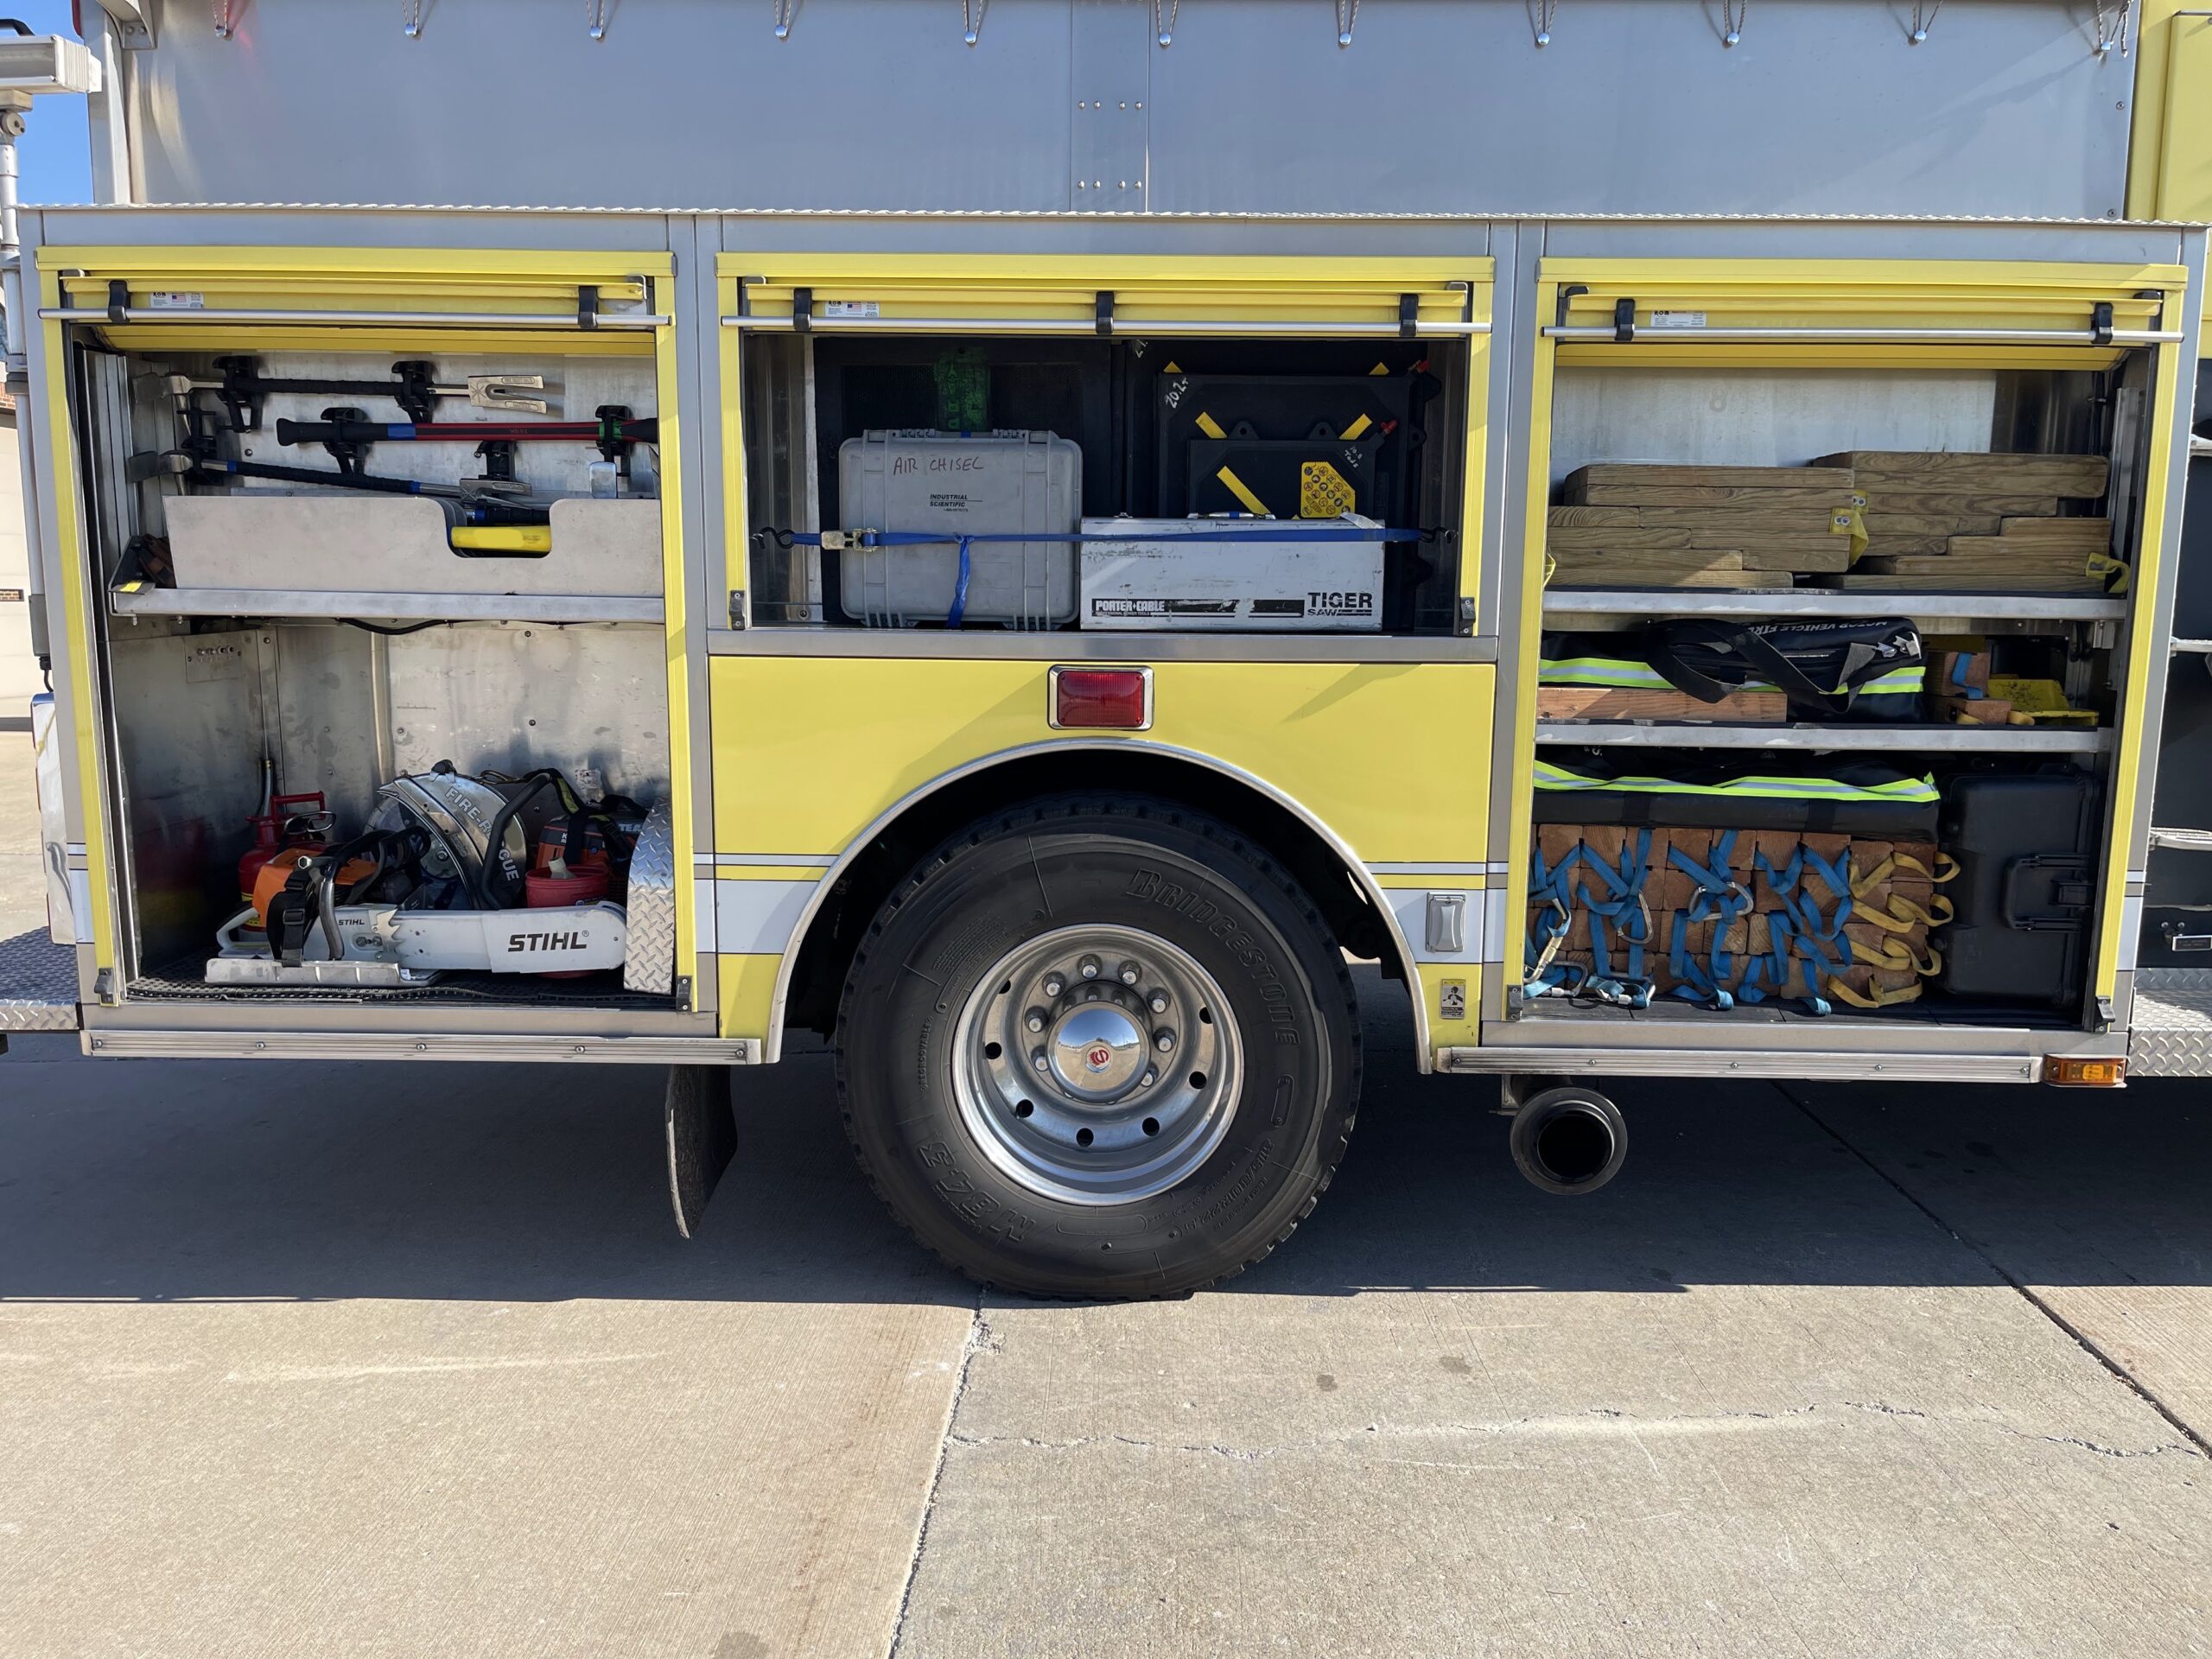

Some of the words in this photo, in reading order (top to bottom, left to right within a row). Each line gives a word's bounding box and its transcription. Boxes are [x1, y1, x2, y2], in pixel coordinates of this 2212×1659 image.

[893, 456, 918, 476] AIR
[930, 456, 984, 472] CHISEL
[1307, 592, 1373, 608] TIGER
[1781, 623, 1836, 632] VEHICLE
[1127, 868, 1301, 1045] BRIDGESTONE
